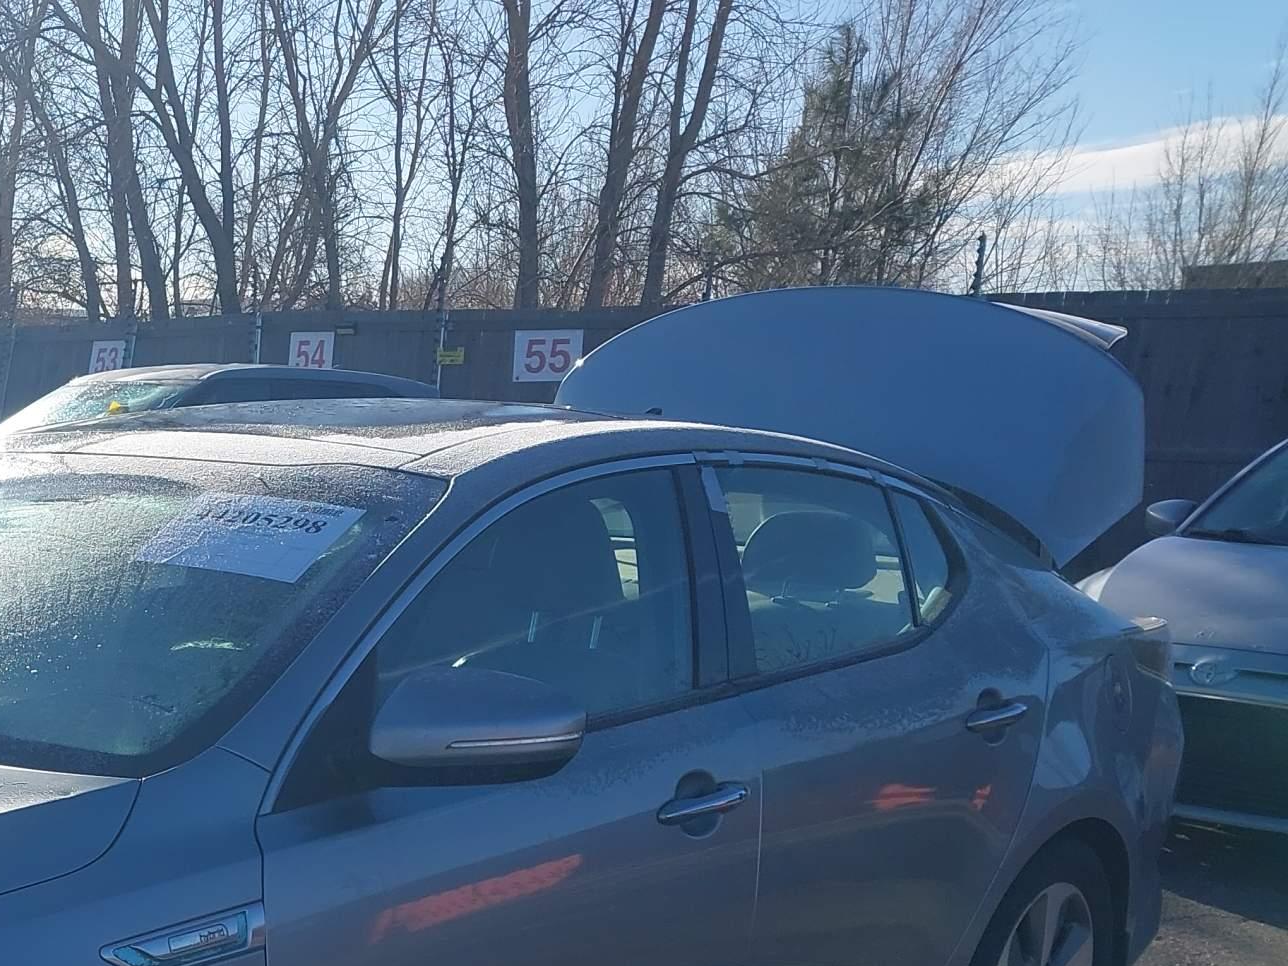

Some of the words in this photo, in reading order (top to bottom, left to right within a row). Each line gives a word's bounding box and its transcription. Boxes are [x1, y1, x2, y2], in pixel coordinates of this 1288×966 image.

[95, 347, 118, 372] 53
[297, 339, 325, 368] 54
[524, 338, 571, 374] 55
